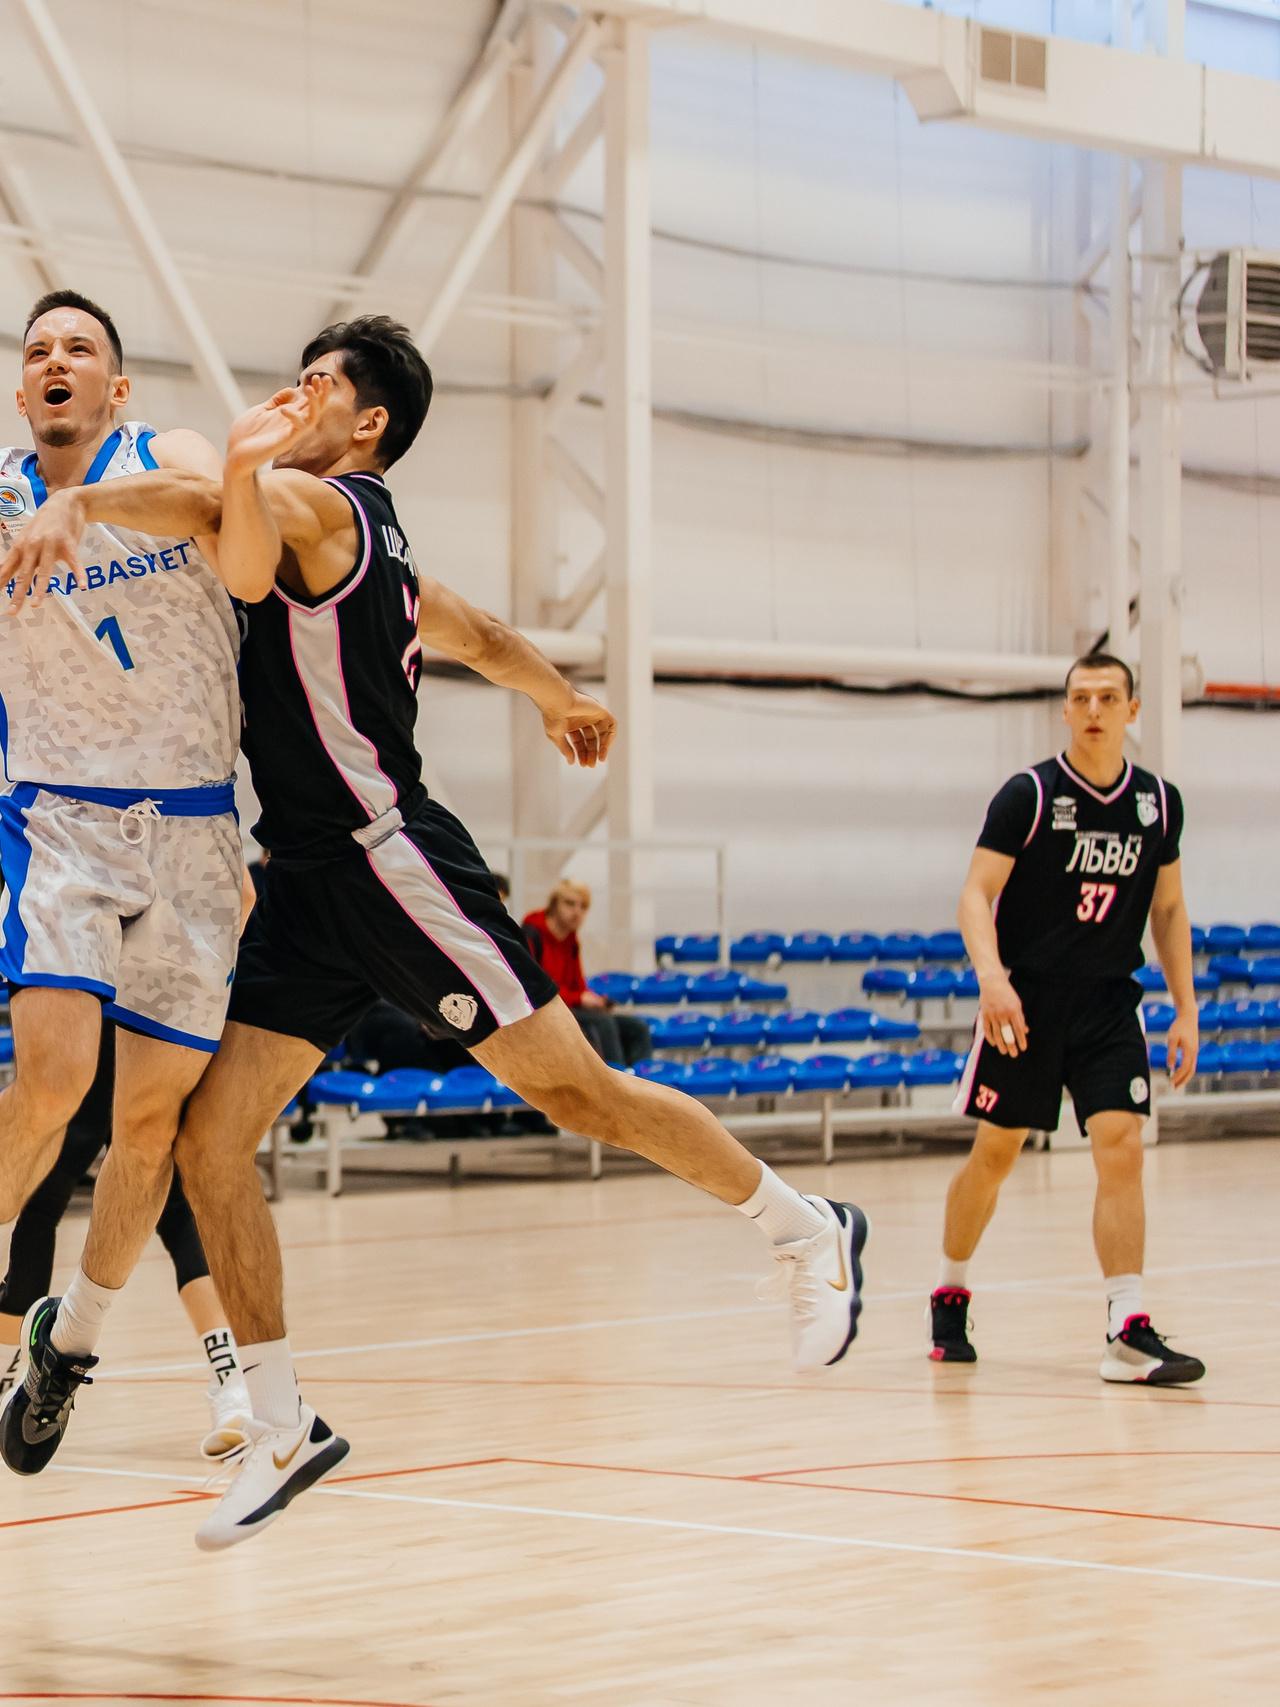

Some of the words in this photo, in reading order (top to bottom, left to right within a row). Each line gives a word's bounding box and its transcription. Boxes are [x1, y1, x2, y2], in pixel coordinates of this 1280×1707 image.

[5, 542, 190, 599] #RABASKET
[94, 615, 135, 671] 1
[1066, 838, 1143, 877] ЛЬВЫ
[1076, 883, 1116, 923] 37
[975, 1084, 1000, 1113] 37
